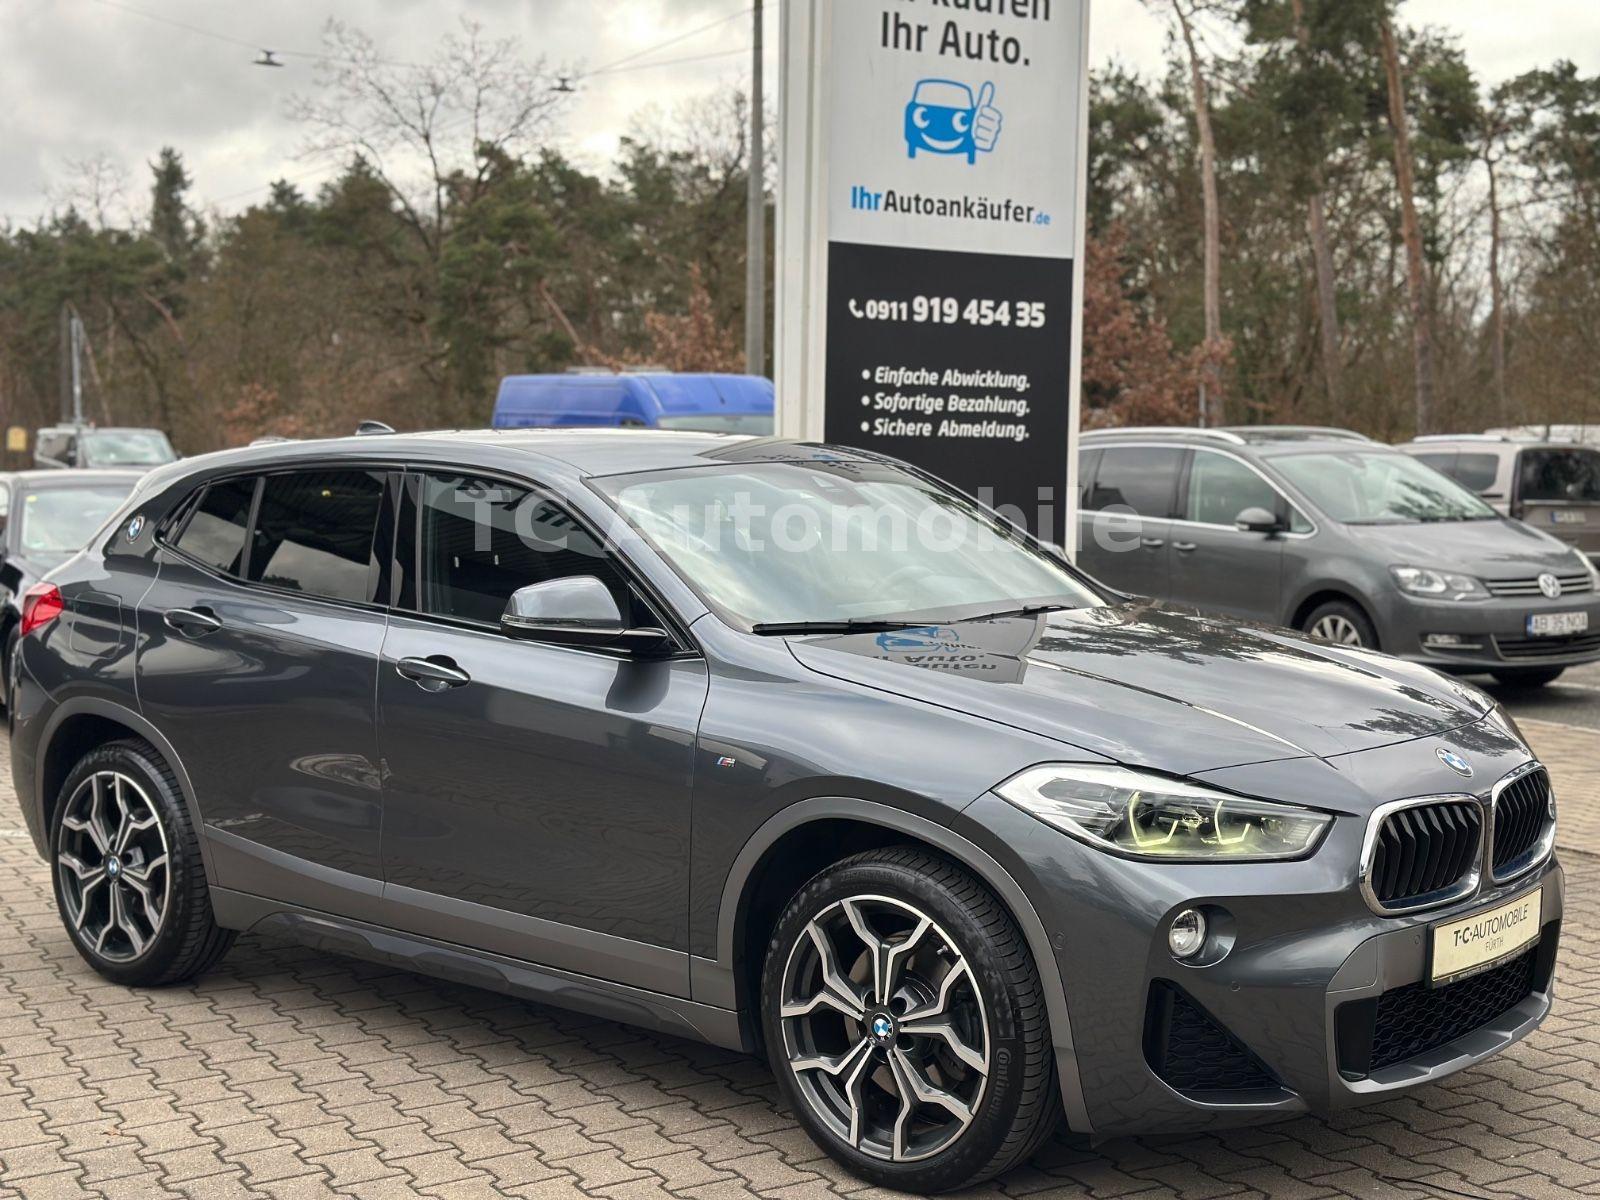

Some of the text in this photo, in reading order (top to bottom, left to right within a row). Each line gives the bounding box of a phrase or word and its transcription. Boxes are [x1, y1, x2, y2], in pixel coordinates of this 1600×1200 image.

[881, 11, 1030, 66] Ihr Auto.
[865, 295, 1045, 328] 0911 919 454 35
[874, 366, 1030, 392] Einfache Abwicklung.
[873, 392, 1030, 417] Sofortige Bezahlung.
[873, 418, 1030, 441] Sichere Abmeldung.
